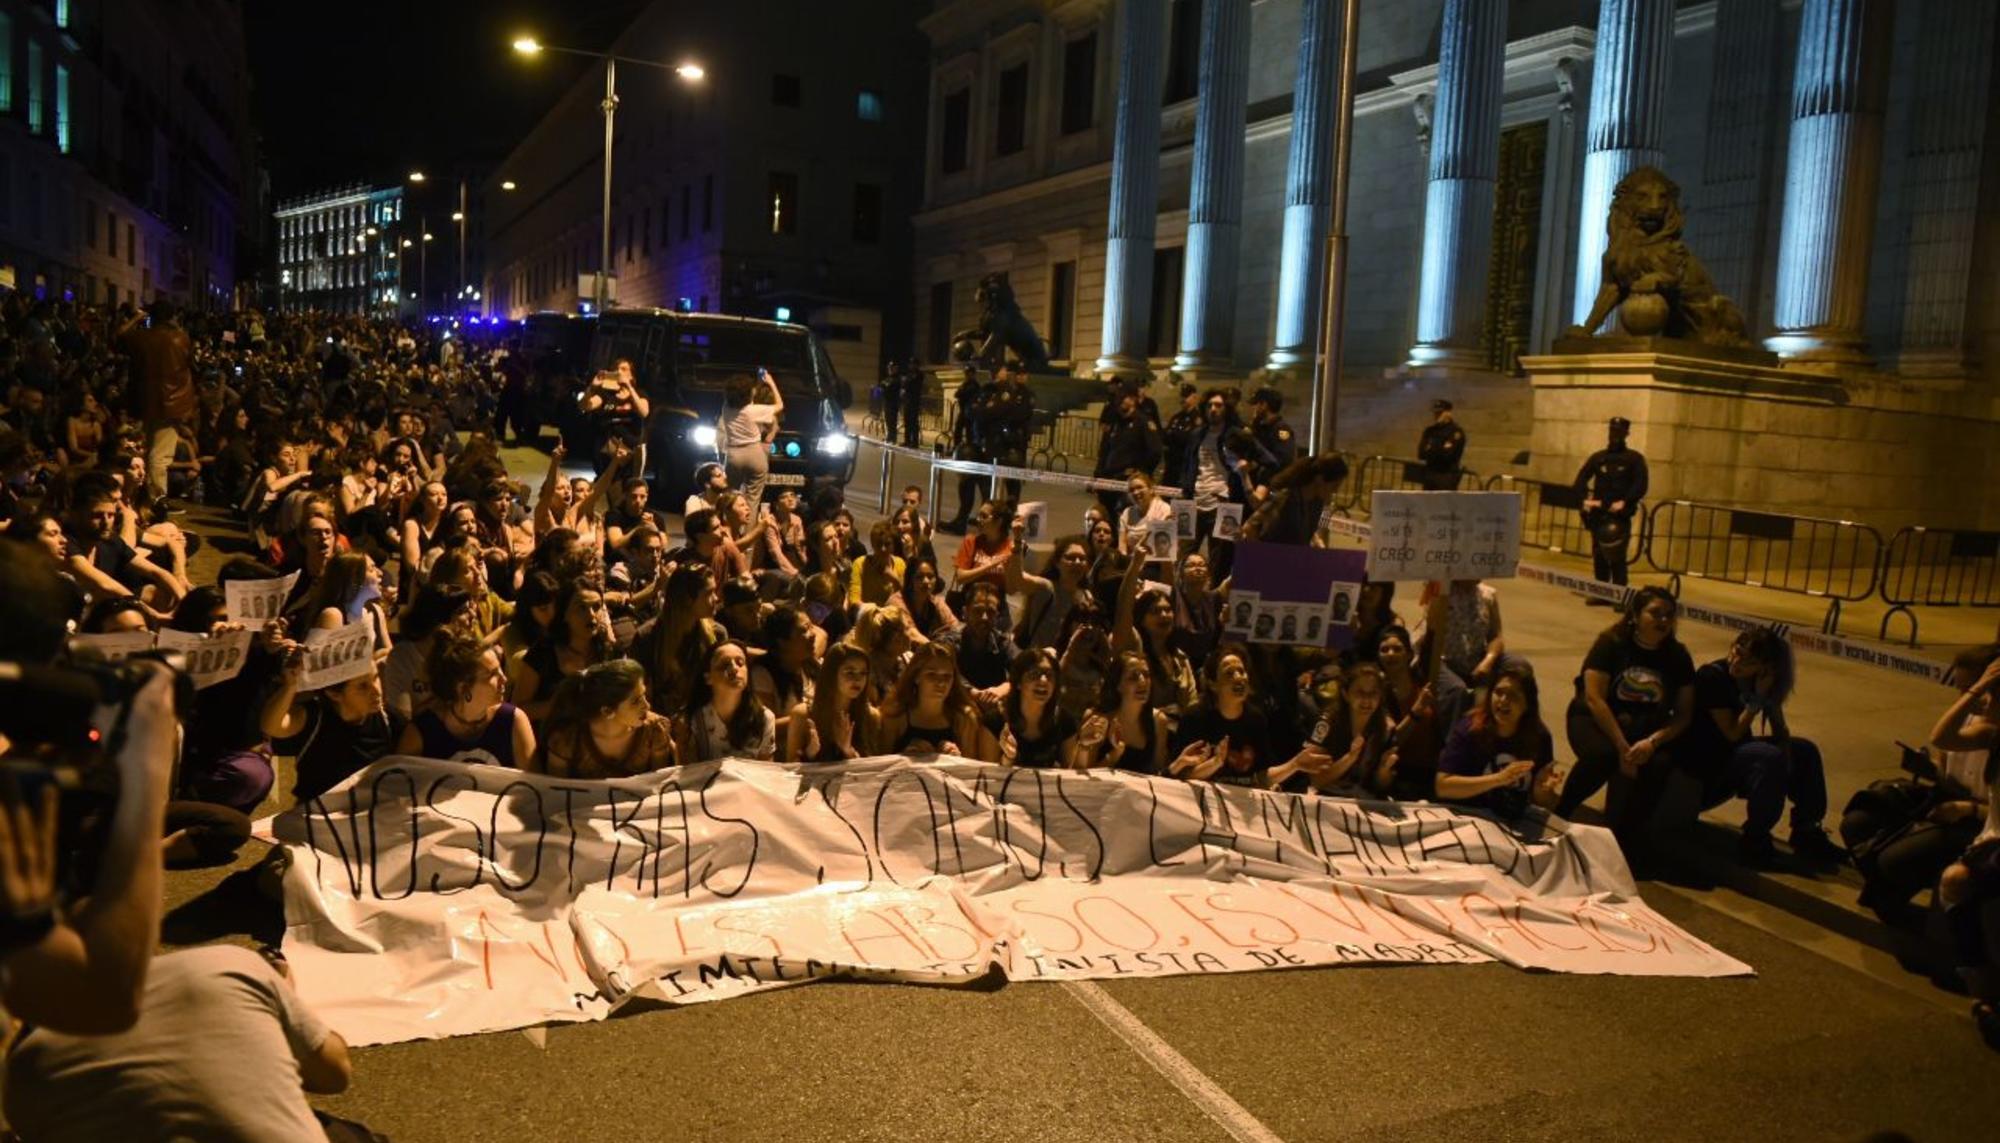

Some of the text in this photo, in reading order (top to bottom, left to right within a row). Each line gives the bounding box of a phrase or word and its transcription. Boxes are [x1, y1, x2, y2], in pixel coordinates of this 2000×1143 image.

[1379, 547, 1507, 567] CREO CREO CREO
[304, 768, 760, 900] NOSOTRAS
[817, 767, 1104, 894] SOMOS
[1148, 779, 1247, 868] LA
[478, 909, 631, 990] NO
[1169, 893, 1300, 949] ES
[1249, 947, 1306, 969] DE
[1335, 941, 1483, 963] MADRI
